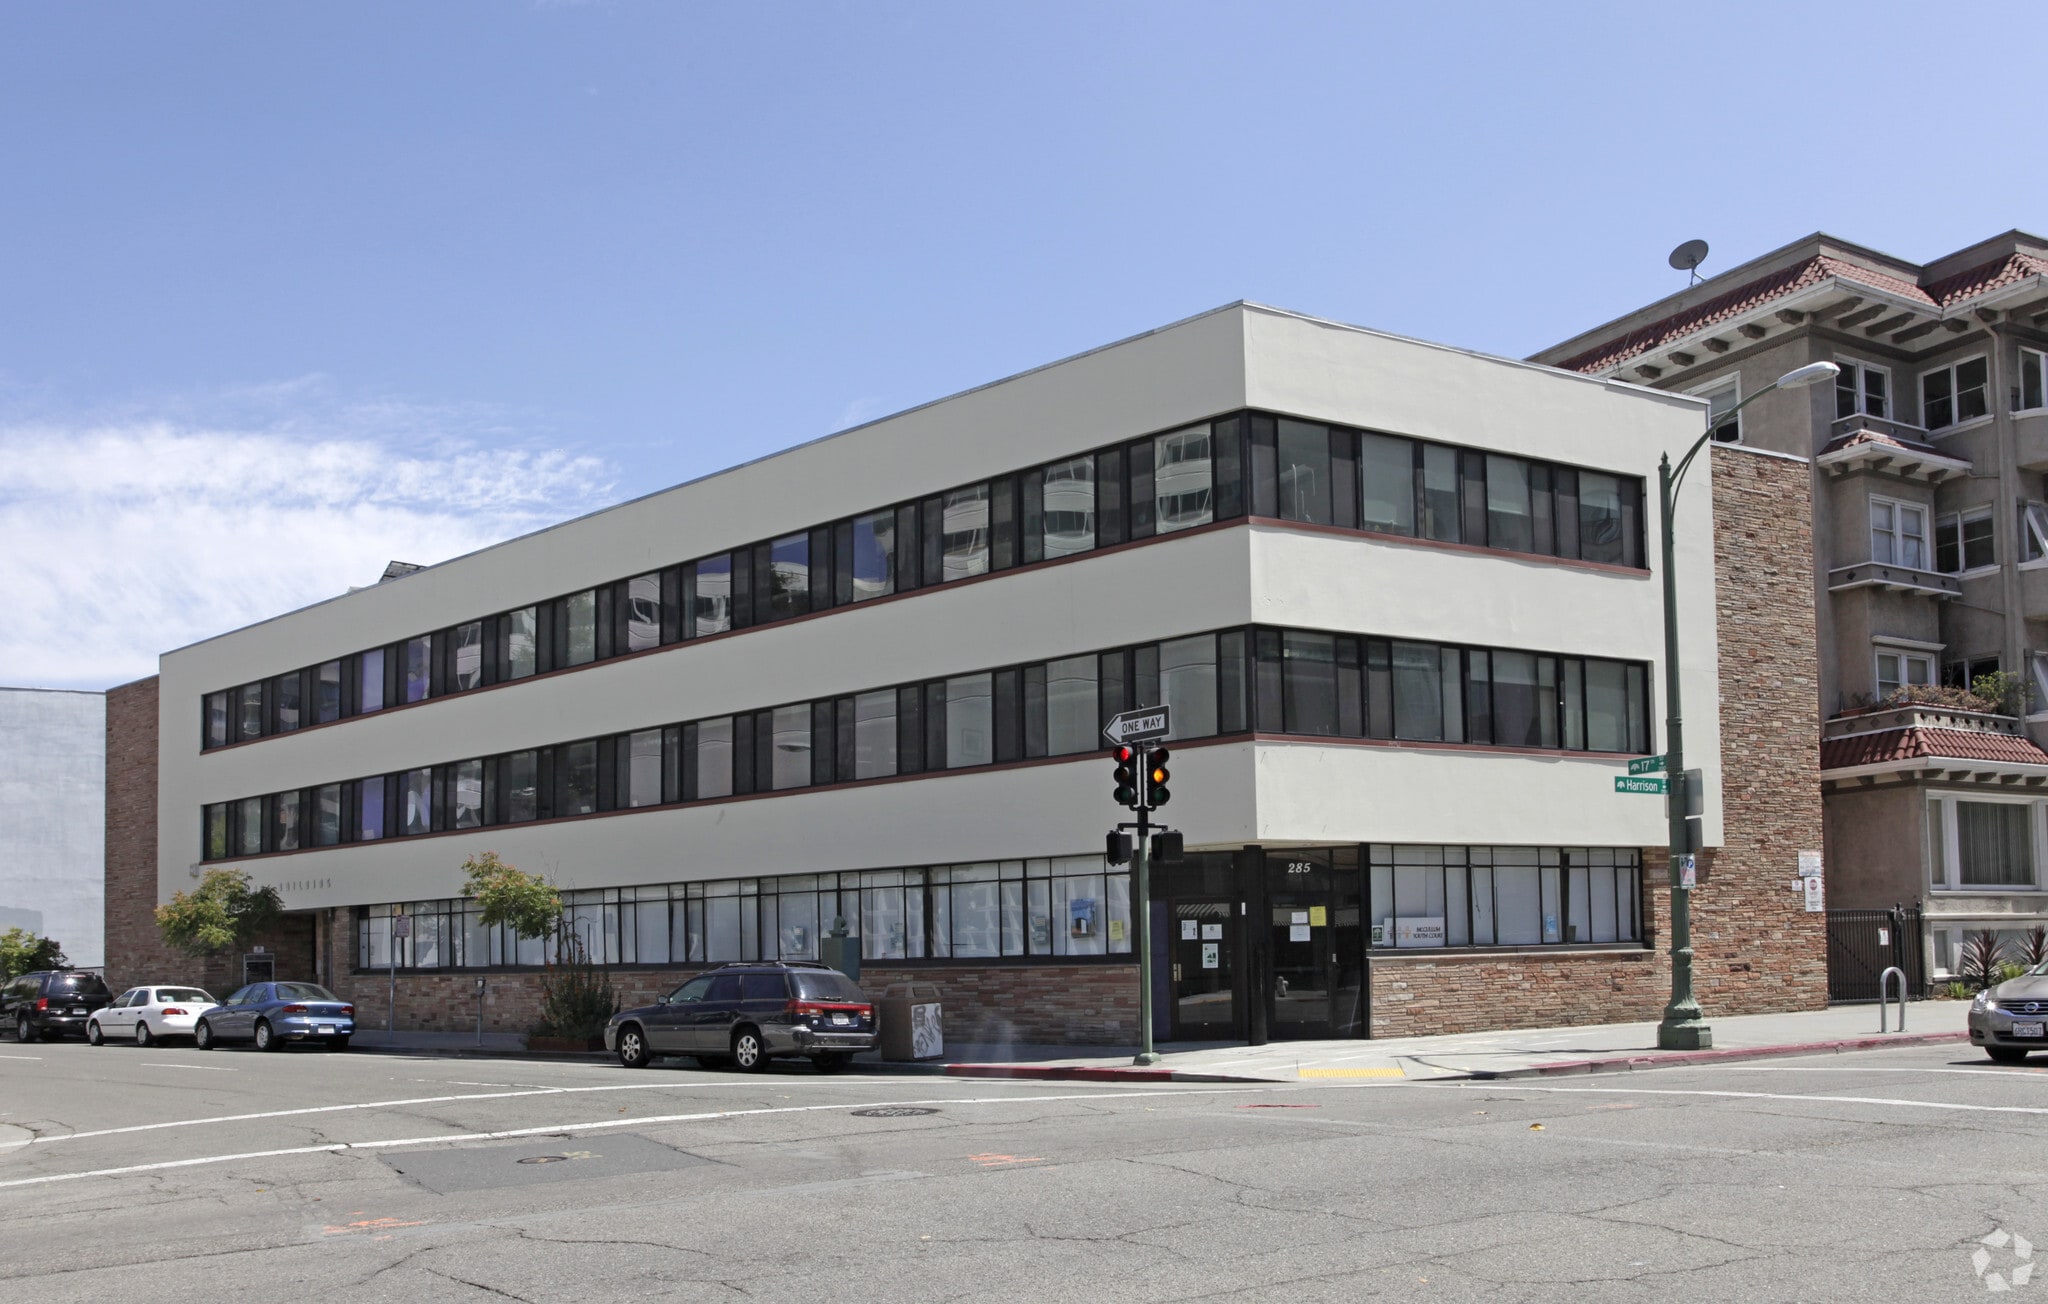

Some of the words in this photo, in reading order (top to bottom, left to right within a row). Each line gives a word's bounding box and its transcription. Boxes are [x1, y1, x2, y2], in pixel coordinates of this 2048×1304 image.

[1121, 721, 1140, 733] ONE
[1143, 716, 1162, 730] WAY
[1626, 779, 1658, 792] Harrison
[1287, 862, 1311, 873] 285
